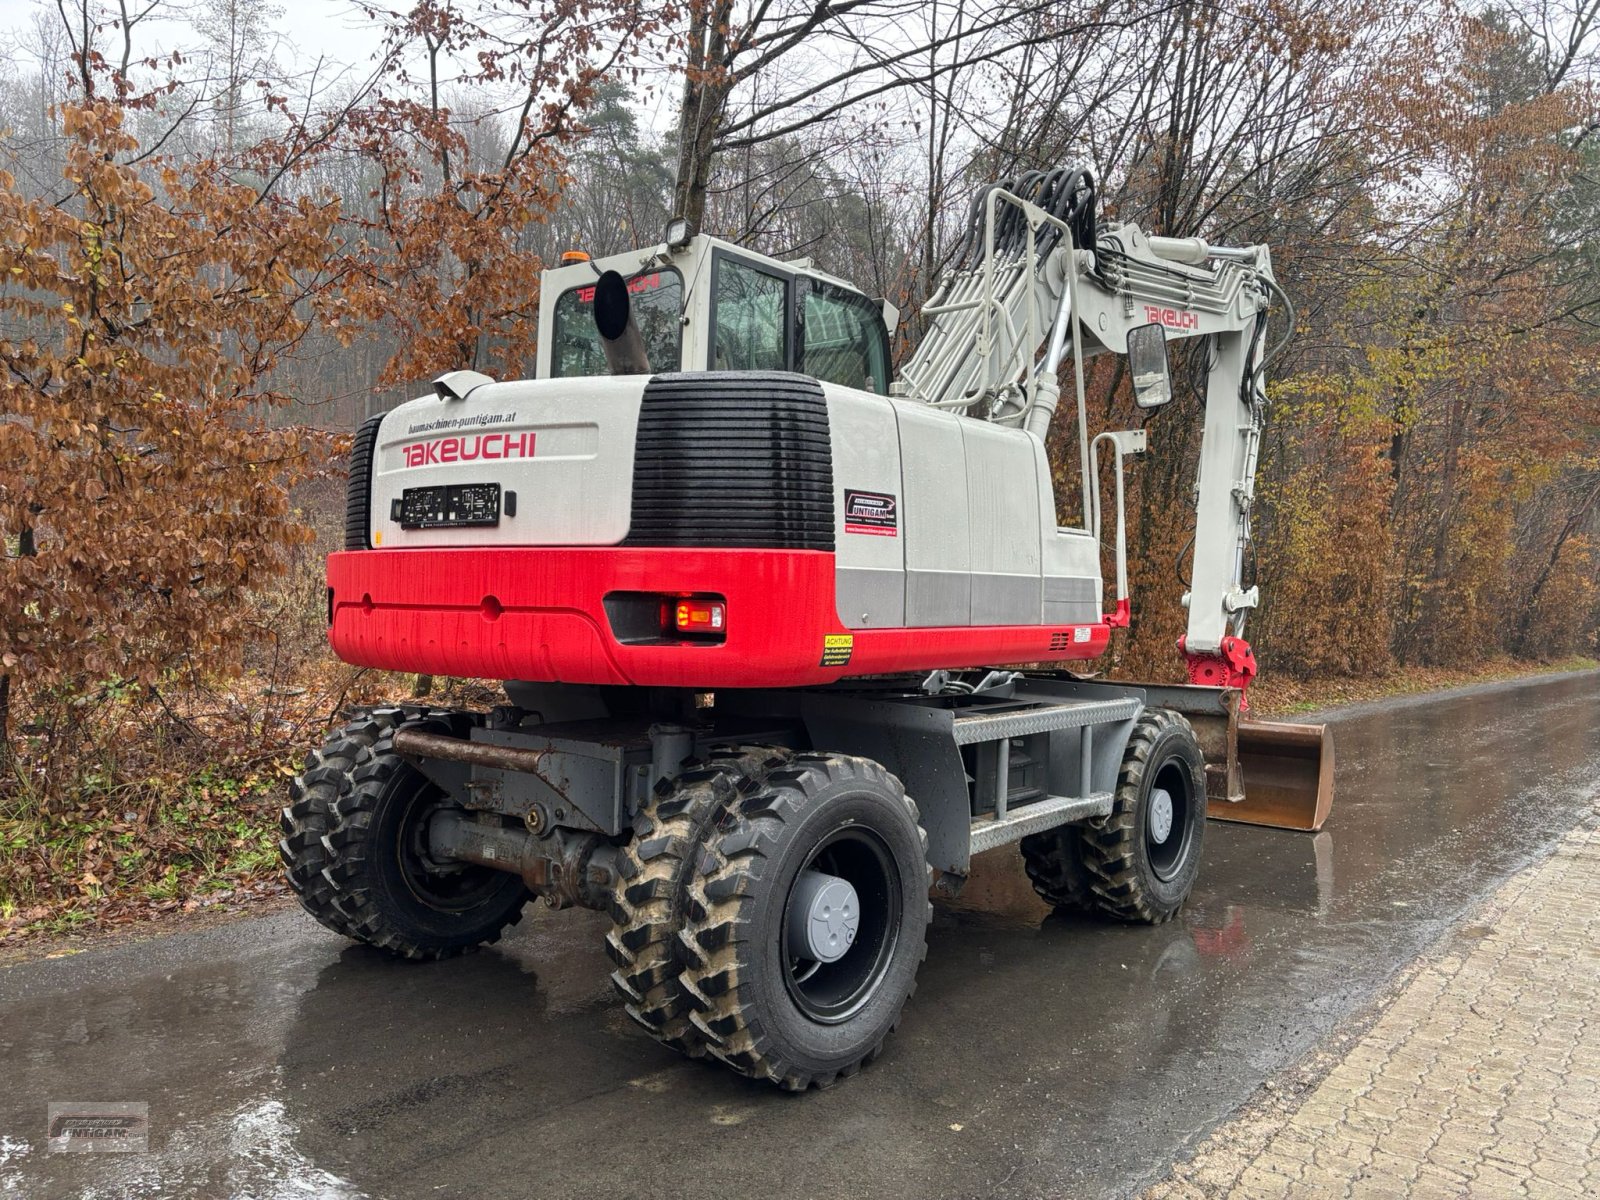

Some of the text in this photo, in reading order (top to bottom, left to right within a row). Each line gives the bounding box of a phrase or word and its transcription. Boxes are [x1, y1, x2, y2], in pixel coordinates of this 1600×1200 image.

[1144, 305, 1198, 330] TAKEUCHI
[408, 412, 517, 434] baumaschinen-puntigam.at
[402, 433, 536, 468] TAKEUCHI
[826, 637, 852, 646] ACHTUNG
